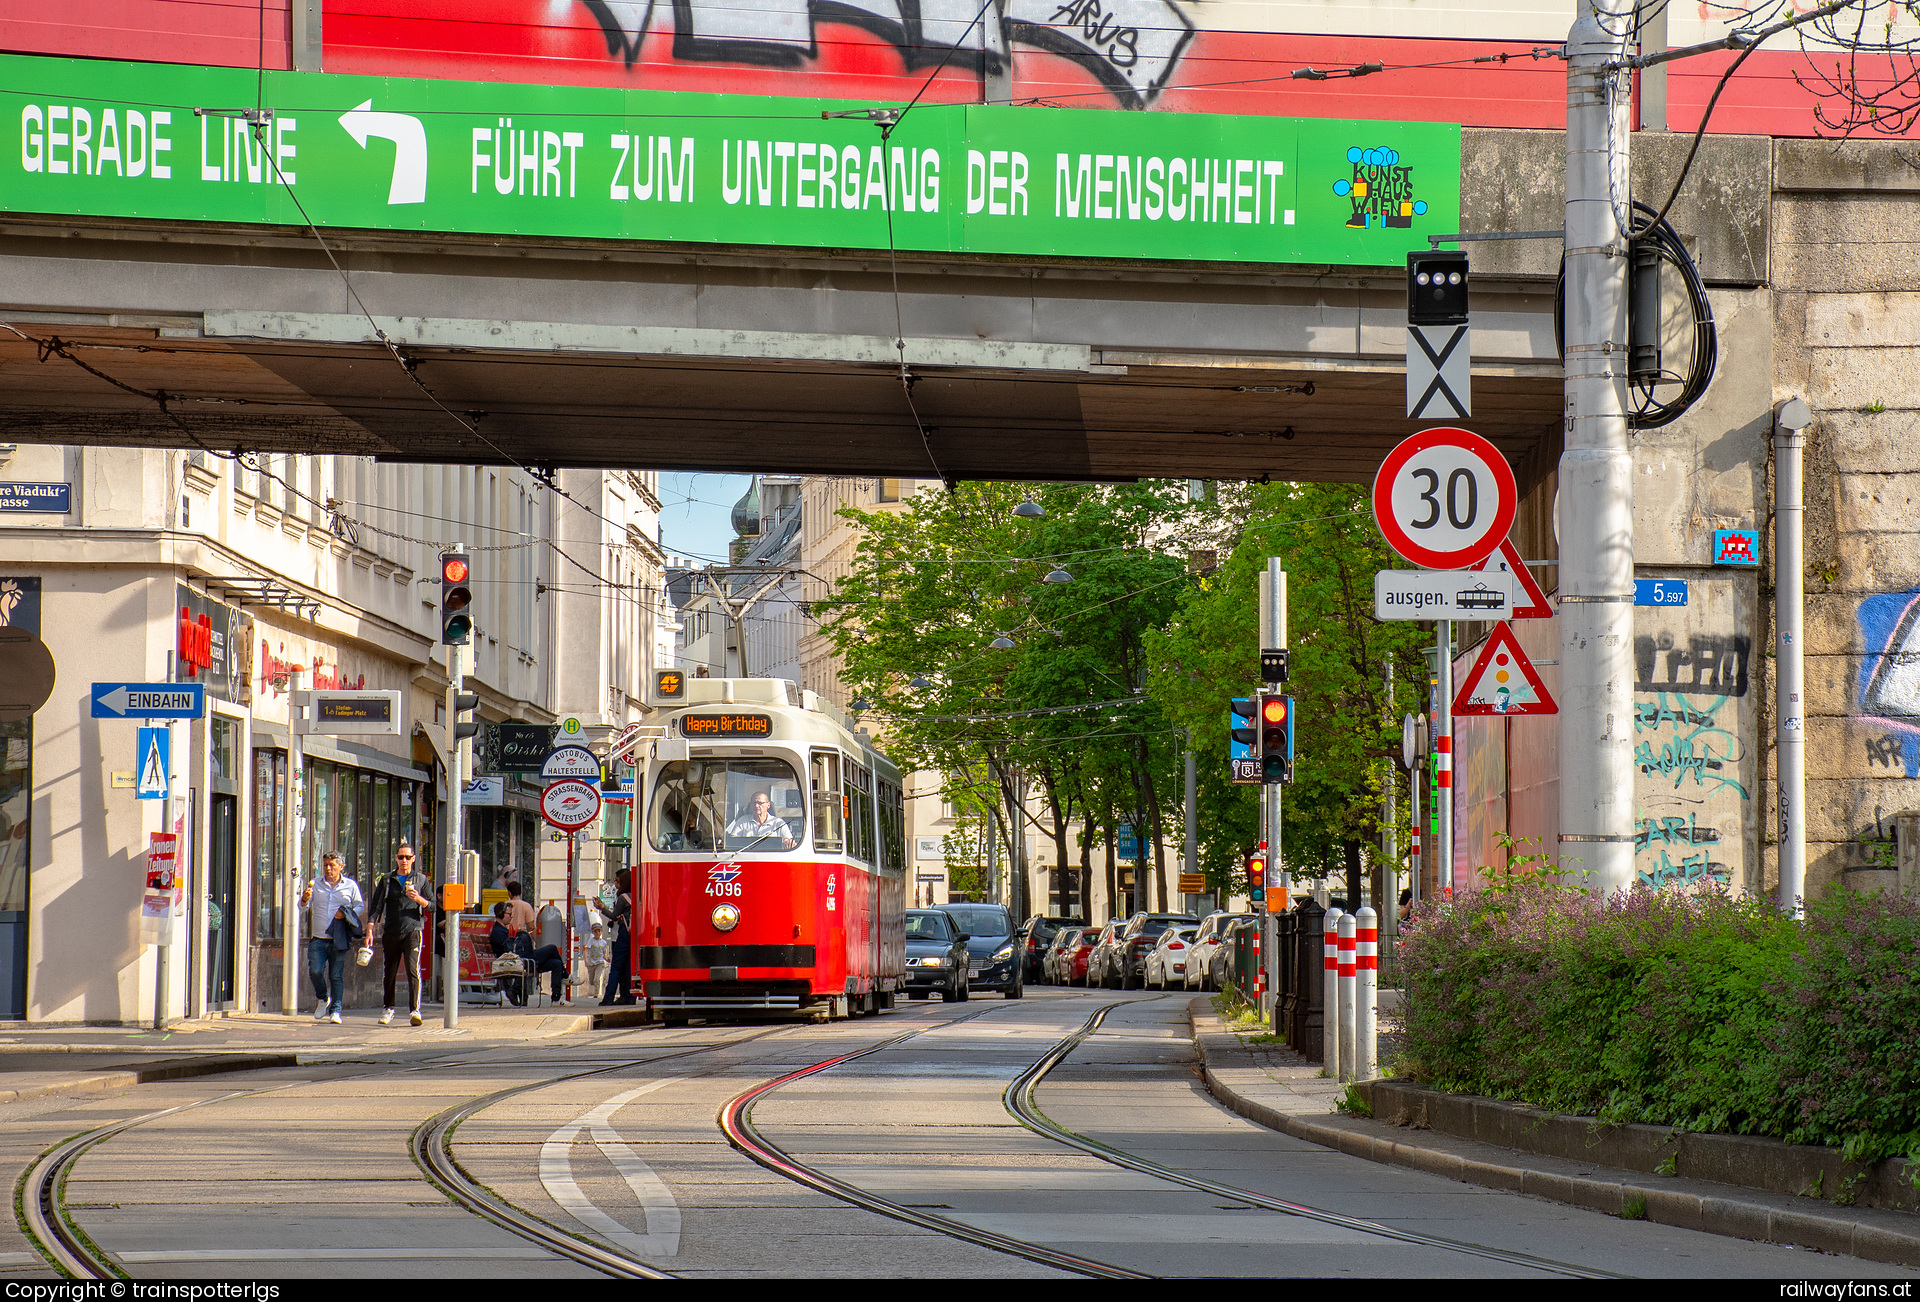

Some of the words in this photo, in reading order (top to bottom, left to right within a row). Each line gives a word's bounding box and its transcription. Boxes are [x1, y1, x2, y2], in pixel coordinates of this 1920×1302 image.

[21, 104, 172, 179] GERADE
[201, 113, 297, 186] LINIE
[472, 119, 584, 198] FÜHRT
[611, 134, 695, 203] ZUM
[723, 139, 940, 213] UNTERGANG
[967, 151, 1029, 216] DER
[1056, 154, 1296, 226] MENSCHHEIT.
[1410, 467, 1478, 530] 30
[1385, 592, 1449, 608] ausgen.
[128, 693, 191, 708] EINBAHN
[383, 706, 389, 715] 3
[567, 721, 576, 732] H
[686, 716, 719, 733] Happy
[720, 716, 768, 733] Birthday
[503, 740, 545, 756] Oishi
[555, 750, 590, 762] AUTOBUS
[547, 767, 595, 775] HALTESTELLE
[1244, 766, 1251, 775] R
[547, 784, 595, 801] STRASSENBAHN
[549, 808, 593, 822] HALTESTELLE
[149, 839, 175, 855] Kronen
[148, 856, 174, 873] Zeitung
[704, 882, 742, 897] 4096
